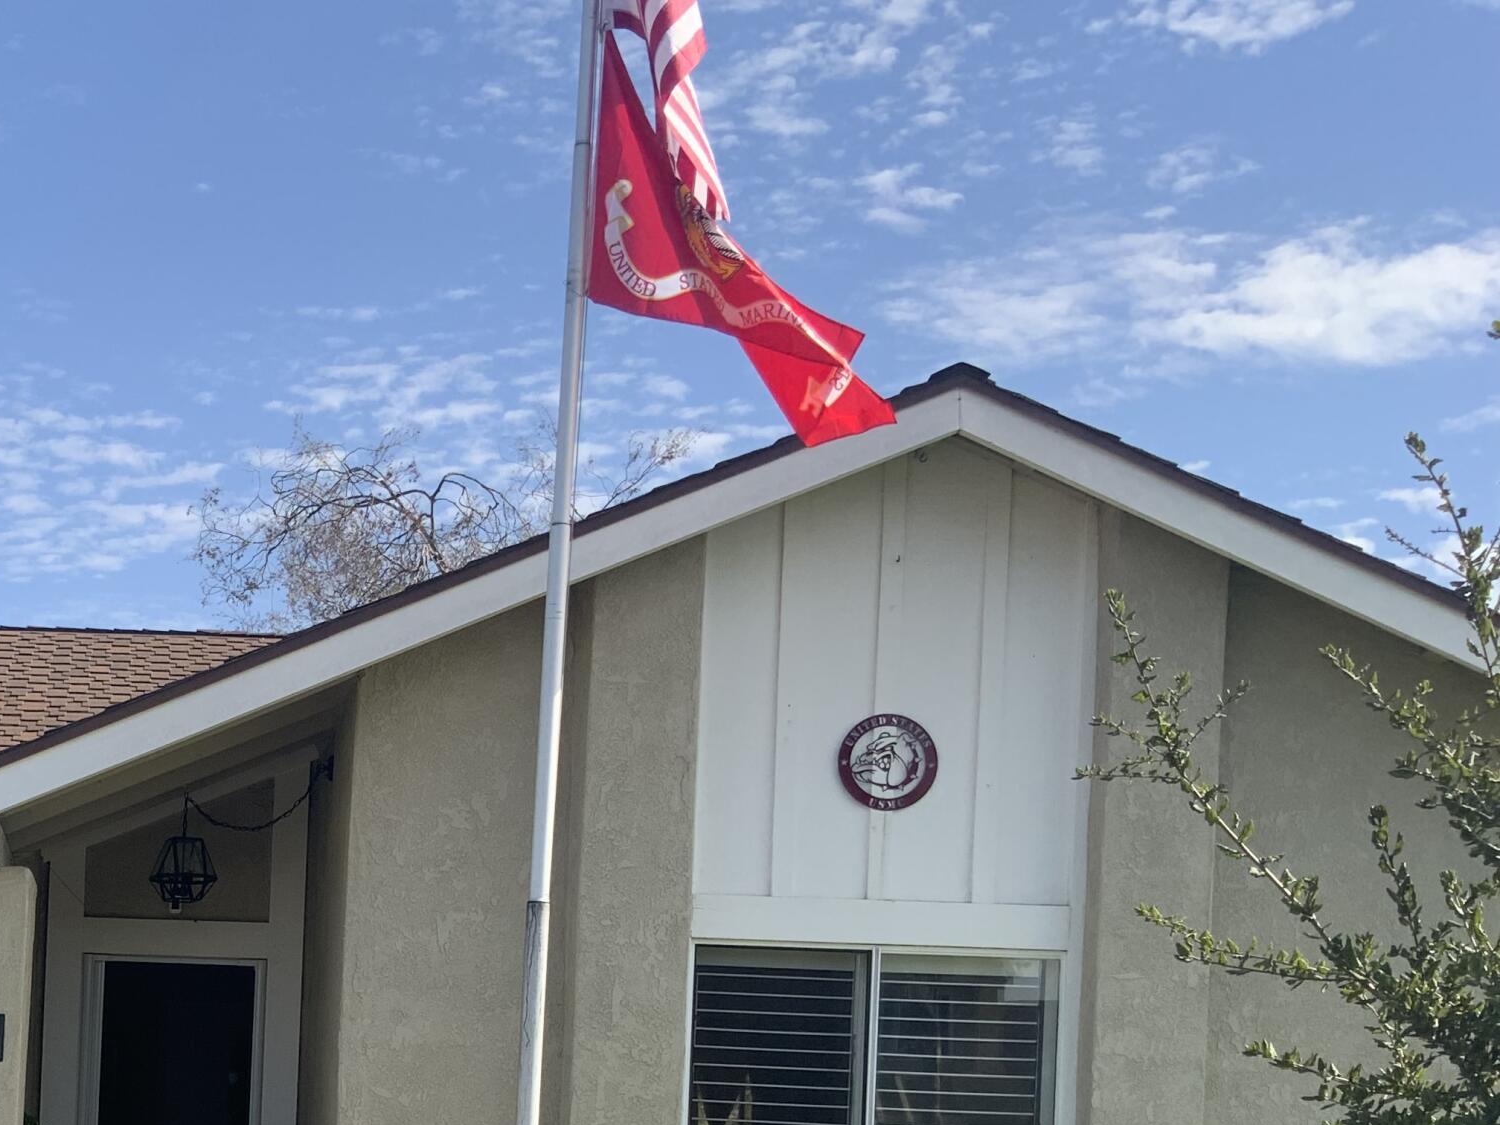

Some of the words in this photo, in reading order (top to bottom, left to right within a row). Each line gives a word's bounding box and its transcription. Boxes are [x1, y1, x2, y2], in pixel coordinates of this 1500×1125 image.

[609, 241, 656, 297] UNITED
[738, 303, 804, 329] MARIN
[845, 717, 886, 747] UNITED
